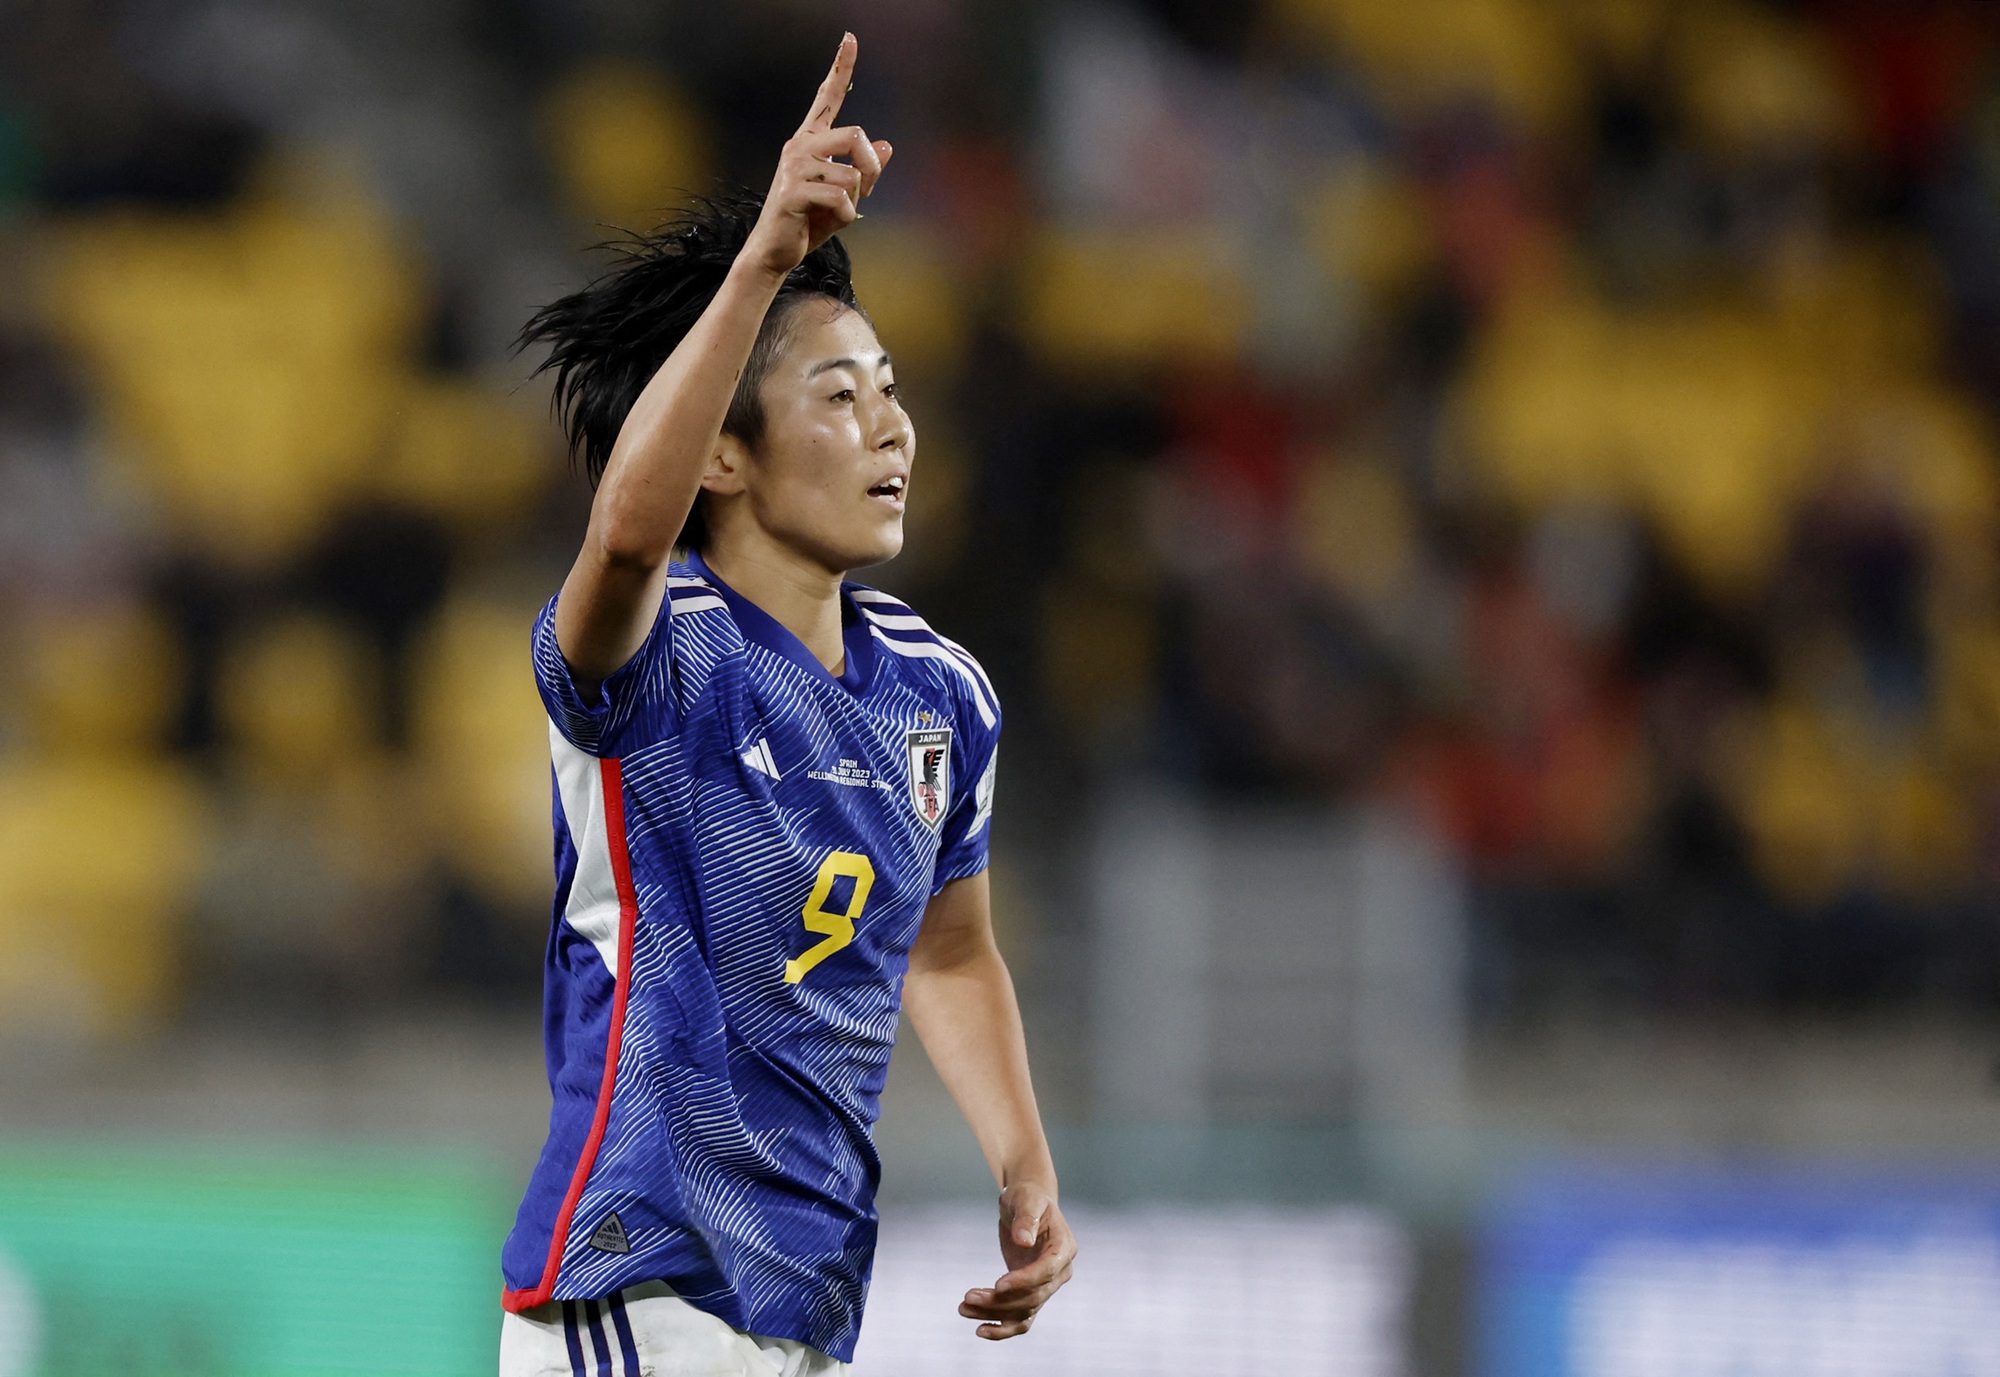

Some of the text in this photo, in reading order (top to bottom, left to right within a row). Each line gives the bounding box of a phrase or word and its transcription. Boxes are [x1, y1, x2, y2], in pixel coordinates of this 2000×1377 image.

[918, 733, 942, 743] JAPAN
[839, 758, 858, 768] SPAIN
[837, 767, 851, 776] JULY
[851, 769, 870, 778] 2023
[839, 776, 869, 787] REGIONAL
[783, 850, 876, 985] 9
